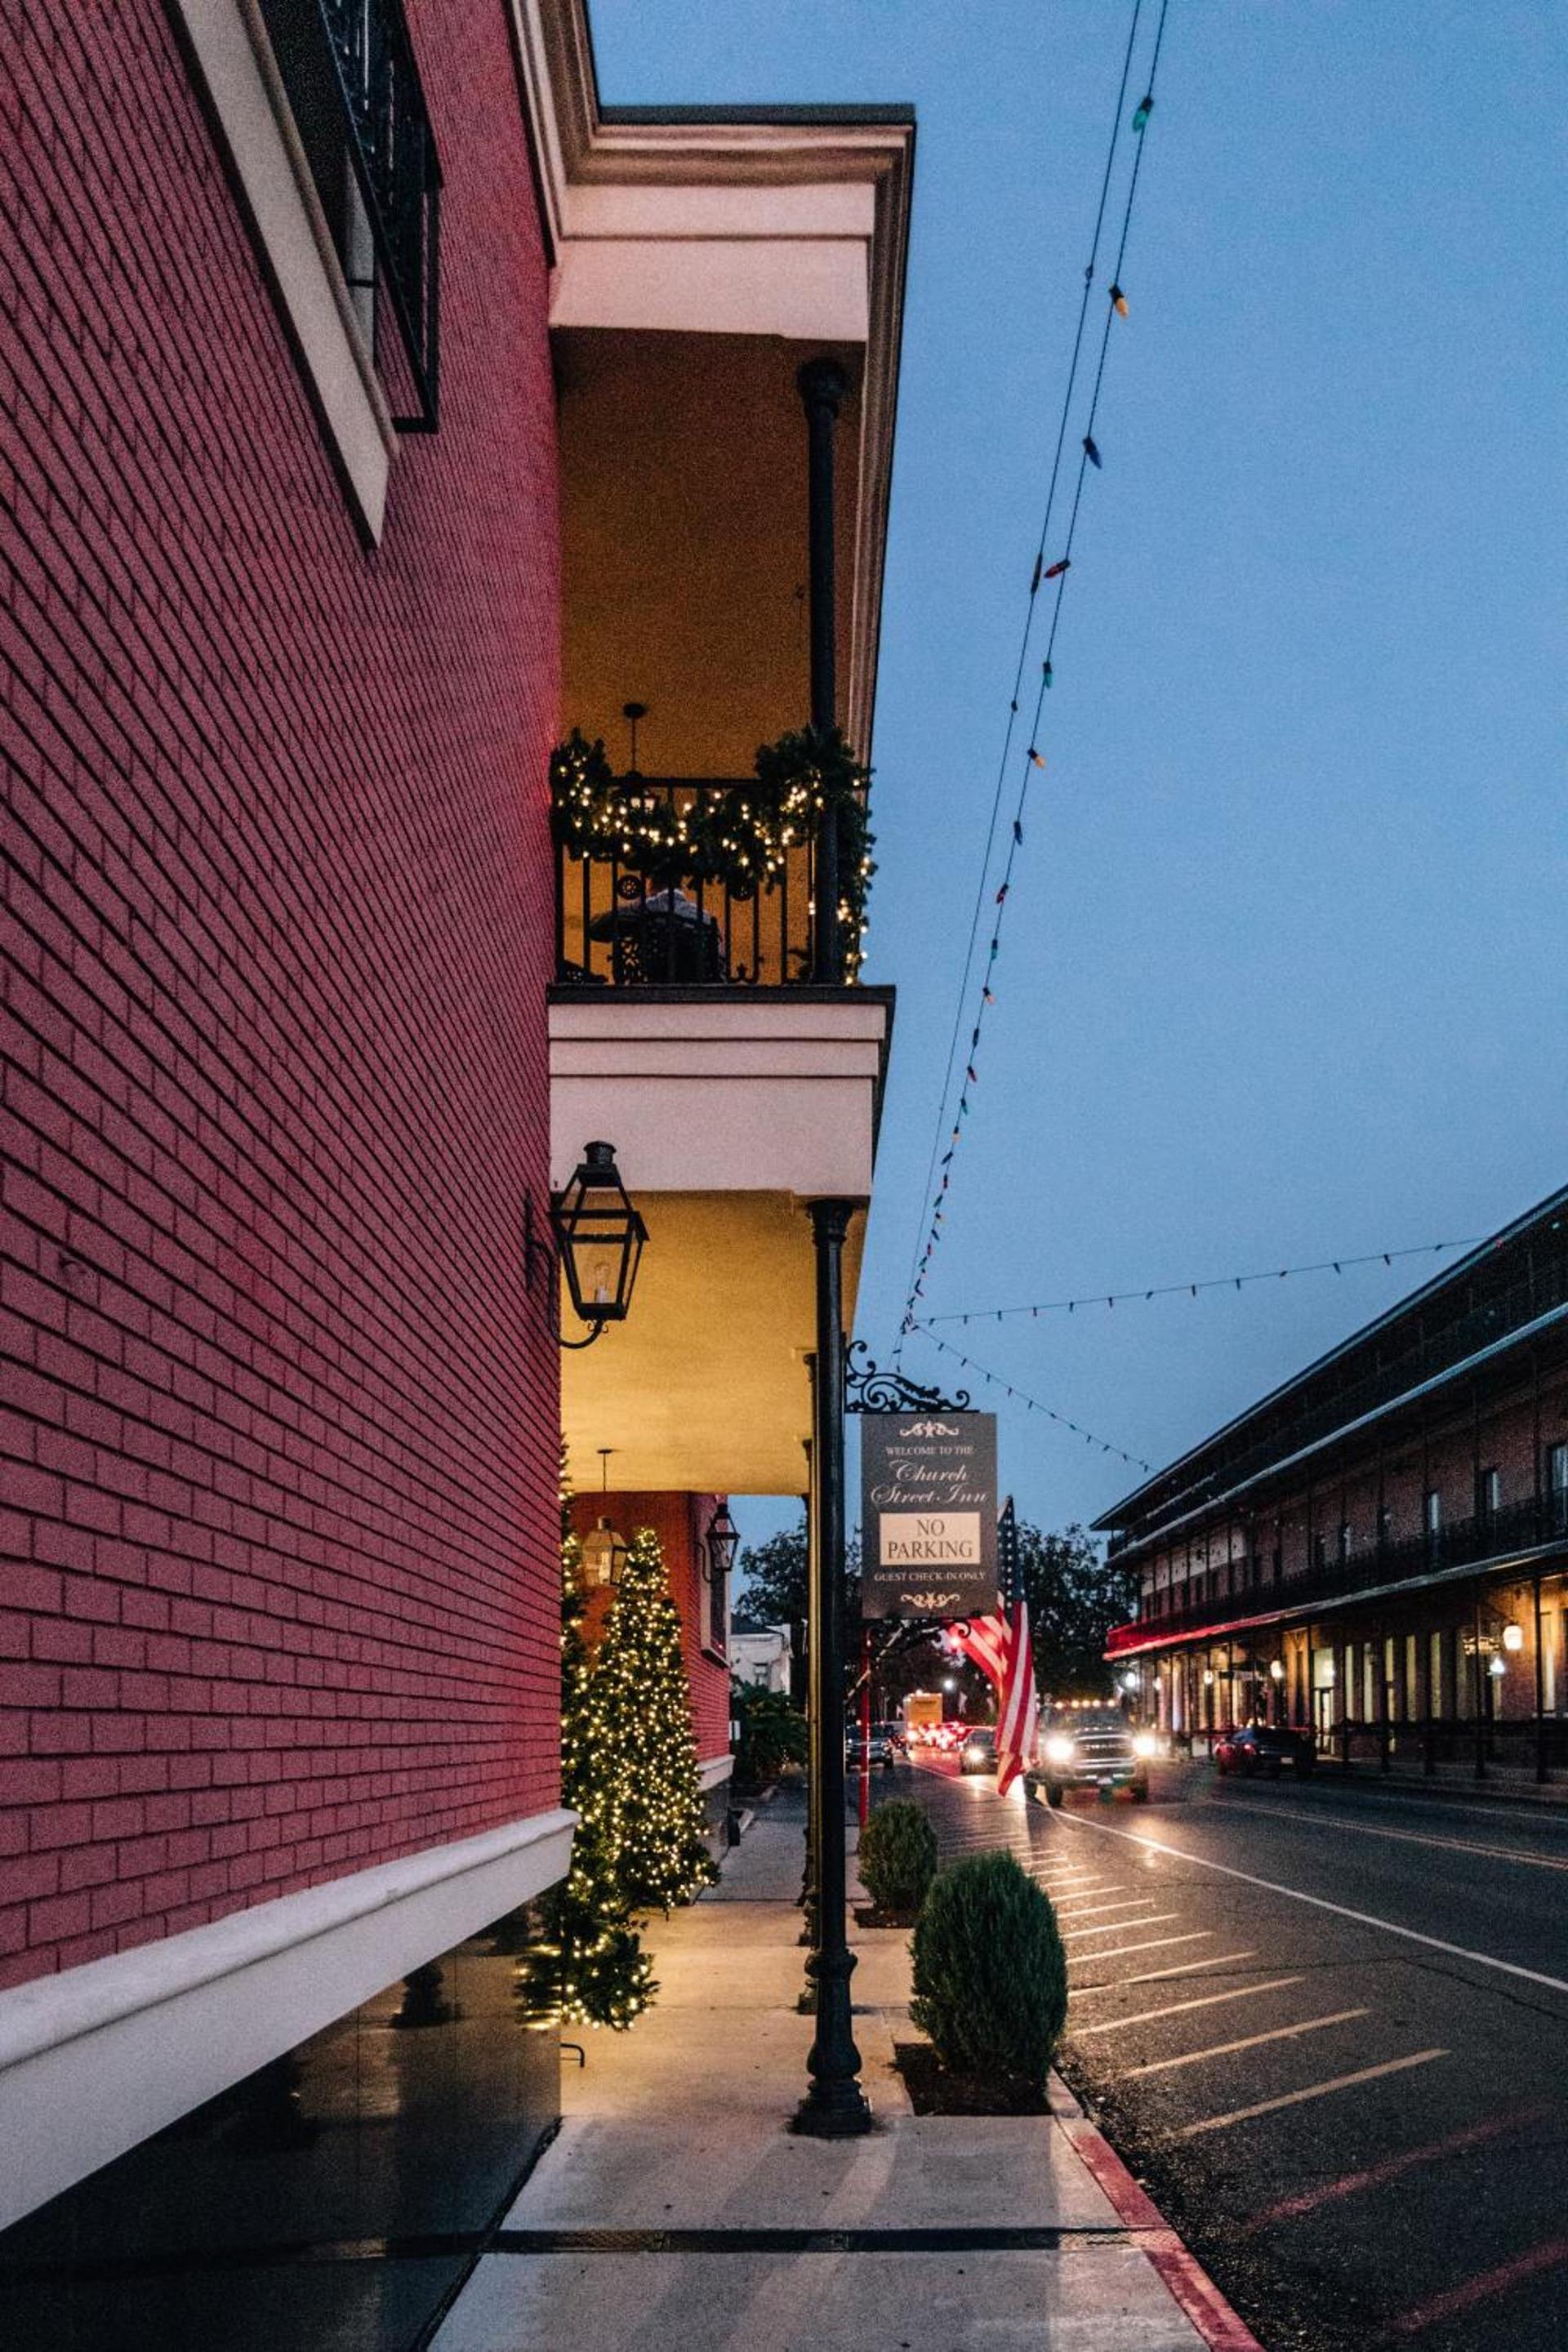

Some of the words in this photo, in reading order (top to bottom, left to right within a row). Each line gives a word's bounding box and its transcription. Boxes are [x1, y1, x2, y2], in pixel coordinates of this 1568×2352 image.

[886, 1446, 935, 1454] WELCOME
[940, 1446, 952, 1454] TO
[956, 1446, 973, 1454] THE
[889, 1459, 967, 1481] Church
[871, 1483, 936, 1504] Street
[943, 1483, 987, 1503] Inn
[916, 1519, 945, 1536] NO
[888, 1540, 973, 1559] PARKING
[874, 1572, 906, 1581] GUEST
[959, 1571, 986, 1581] ONLY
